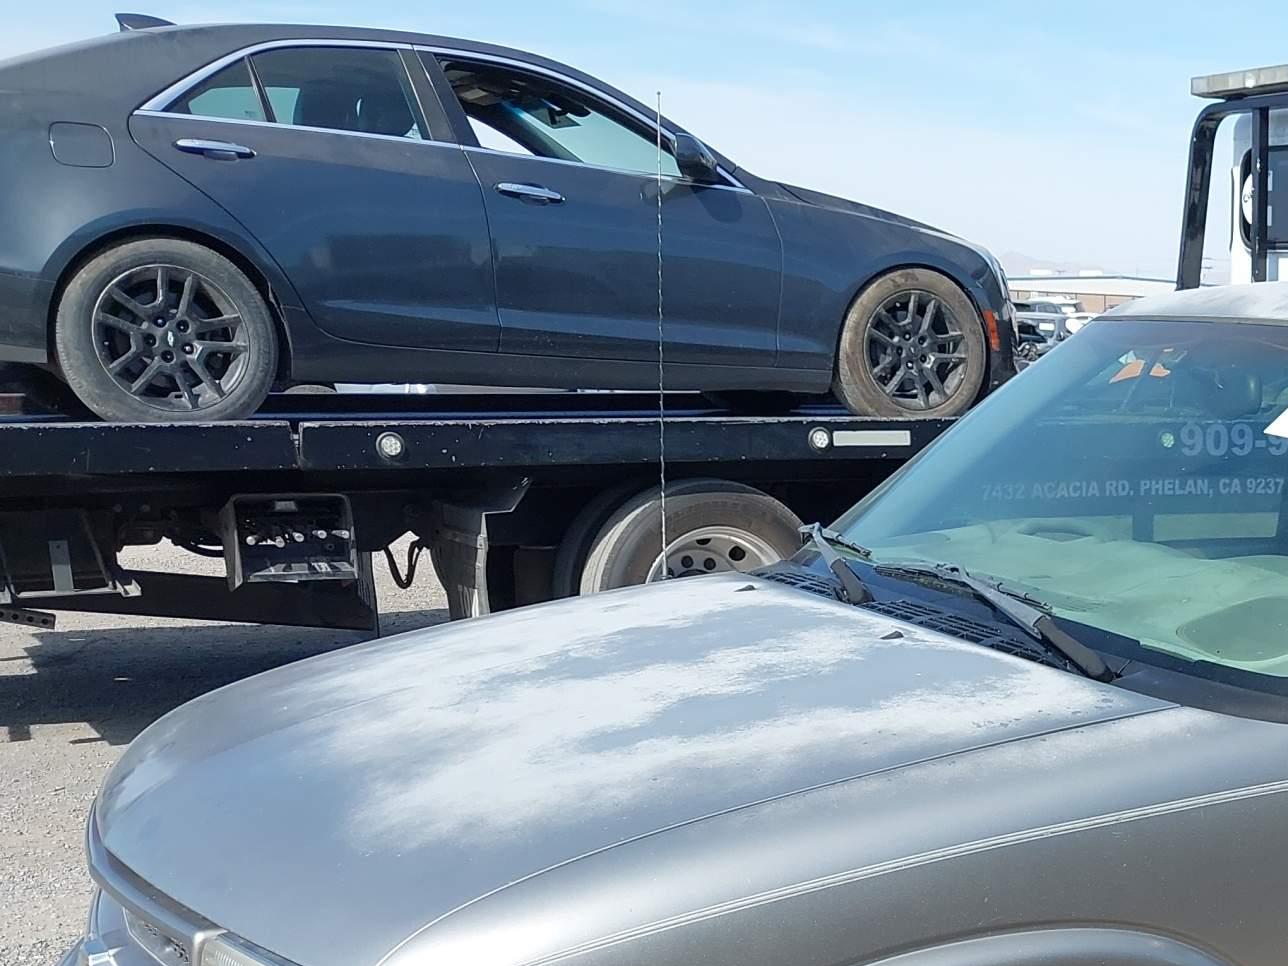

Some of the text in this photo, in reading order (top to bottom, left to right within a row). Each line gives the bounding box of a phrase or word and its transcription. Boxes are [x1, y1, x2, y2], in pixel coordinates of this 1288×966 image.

[980, 477, 1285, 500] 7432 ACACIA RD. PHELAN, CA 9237
